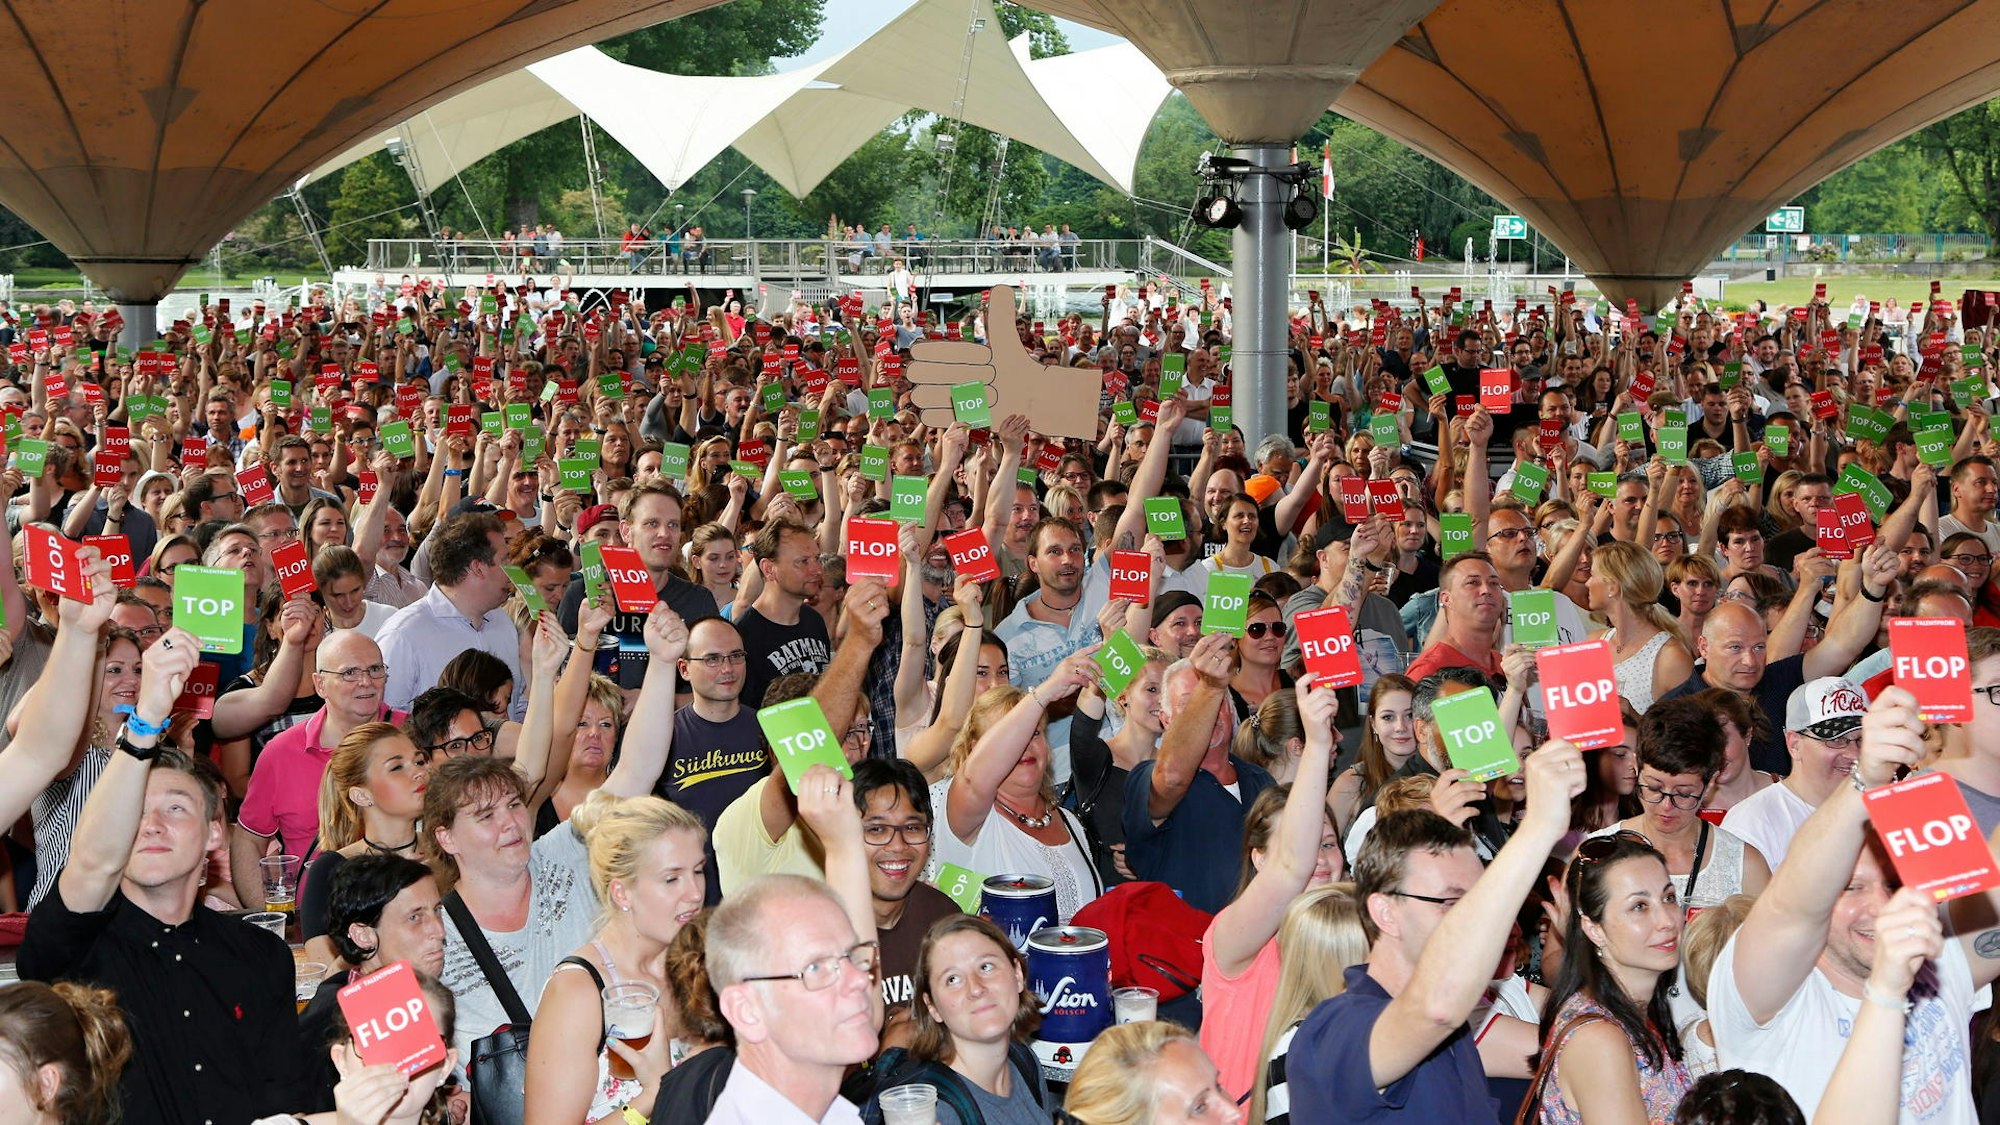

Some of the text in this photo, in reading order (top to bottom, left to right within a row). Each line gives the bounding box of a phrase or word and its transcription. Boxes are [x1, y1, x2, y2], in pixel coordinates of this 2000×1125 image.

[850, 304, 862, 312] FLOP
[879, 325, 894, 333] FLOP
[1671, 338, 1684, 349] FLOP
[1822, 335, 1837, 344] FLOP
[878, 347, 892, 357] FLOP
[1965, 352, 1980, 360] TOP
[140, 359, 158, 367] FLOP
[669, 358, 680, 371] TOP
[764, 361, 780, 369] FLOP
[884, 362, 901, 370] FLOP
[323, 371, 340, 379] FLOP
[361, 368, 377, 376] FLOP
[839, 366, 858, 374] FLOP
[1724, 370, 1739, 379] TOP
[1164, 370, 1181, 382] TOP
[808, 377, 826, 387] FLOP
[1429, 376, 1444, 387] TOP
[1633, 380, 1651, 393] FLOP
[47, 382, 65, 392] FLOP
[560, 387, 577, 395] FLOP
[602, 382, 620, 392] TOP
[1481, 385, 1510, 397] FLOP
[1970, 383, 1983, 392] OP
[84, 389, 100, 397] FLOP
[273, 390, 289, 398] TOP
[402, 393, 419, 401] FLOP
[766, 391, 782, 402] TOP
[1213, 393, 1230, 401] FLOP
[130, 403, 147, 412] TOP
[150, 403, 165, 412] TOP
[872, 400, 890, 409] TOP
[957, 397, 983, 412] TOP
[1382, 398, 1400, 407] FLOP
[1817, 399, 1833, 409] LOP
[509, 413, 528, 422] TOP
[1117, 408, 1133, 418] TOP
[1312, 412, 1328, 422] TOP
[314, 417, 329, 425] TOP
[448, 415, 470, 425] FLOP
[1213, 415, 1230, 424] TOP
[1667, 419, 1685, 428] TOP
[1851, 415, 1870, 427] TOP
[801, 421, 816, 429] TOP
[1621, 423, 1640, 432] TOP
[1869, 420, 1888, 434] TOP
[1376, 426, 1395, 435] TOP
[1540, 429, 1560, 437] FLOP
[106, 438, 129, 446] FLOP
[385, 433, 407, 444] TOP
[527, 438, 539, 447] TOP
[1768, 436, 1786, 445] TOP
[1661, 441, 1684, 450] TOP
[1921, 442, 1945, 454] TOP
[21, 452, 43, 461] TOP
[184, 448, 206, 456] FLOP
[578, 451, 597, 461] TOP
[741, 447, 764, 457] FLOP
[1040, 450, 1061, 463] FLOP
[666, 456, 685, 466] TOP
[864, 456, 884, 466] TOP
[96, 464, 120, 473] FLOP
[1737, 463, 1756, 473] TOP
[564, 470, 586, 479] TOP
[242, 477, 268, 494] FLOP
[360, 483, 378, 492] FLO
[785, 479, 809, 487] TOP
[1518, 475, 1540, 490] TOP
[1592, 481, 1614, 489] TOP
[1844, 474, 1868, 491] TOP
[896, 493, 923, 505] TOP
[1344, 493, 1366, 505] FLOP
[1373, 493, 1399, 506] FLOP
[1868, 488, 1886, 509] TOP
[1151, 512, 1178, 522] TOP
[1840, 511, 1868, 528] FLOP
[1445, 530, 1469, 541] TOP
[1819, 527, 1845, 539] FLO
[849, 540, 897, 558] FLOP
[106, 554, 130, 567] OP
[953, 545, 990, 566] FLOP
[49, 535, 67, 593] FLOP
[278, 560, 308, 579] FLOP
[585, 563, 601, 580] TOP
[609, 568, 649, 584] FLOP
[1112, 568, 1149, 583] FLOP
[182, 596, 235, 617] TOP
[1211, 595, 1243, 611] TOP
[1516, 611, 1551, 627] TOP
[1302, 634, 1352, 659] FLOP
[767, 638, 828, 671] BATMAN
[1105, 648, 1132, 678] TOP
[1896, 655, 1966, 679] FLOP
[184, 681, 215, 697] LOP
[1546, 679, 1614, 711] FLOP
[1448, 720, 1496, 749] TOP
[778, 728, 826, 756] TOP
[673, 749, 764, 778] Südkurve
[1884, 814, 1972, 858] FLOP
[951, 874, 969, 895] OP
[355, 998, 424, 1049] FLOP
